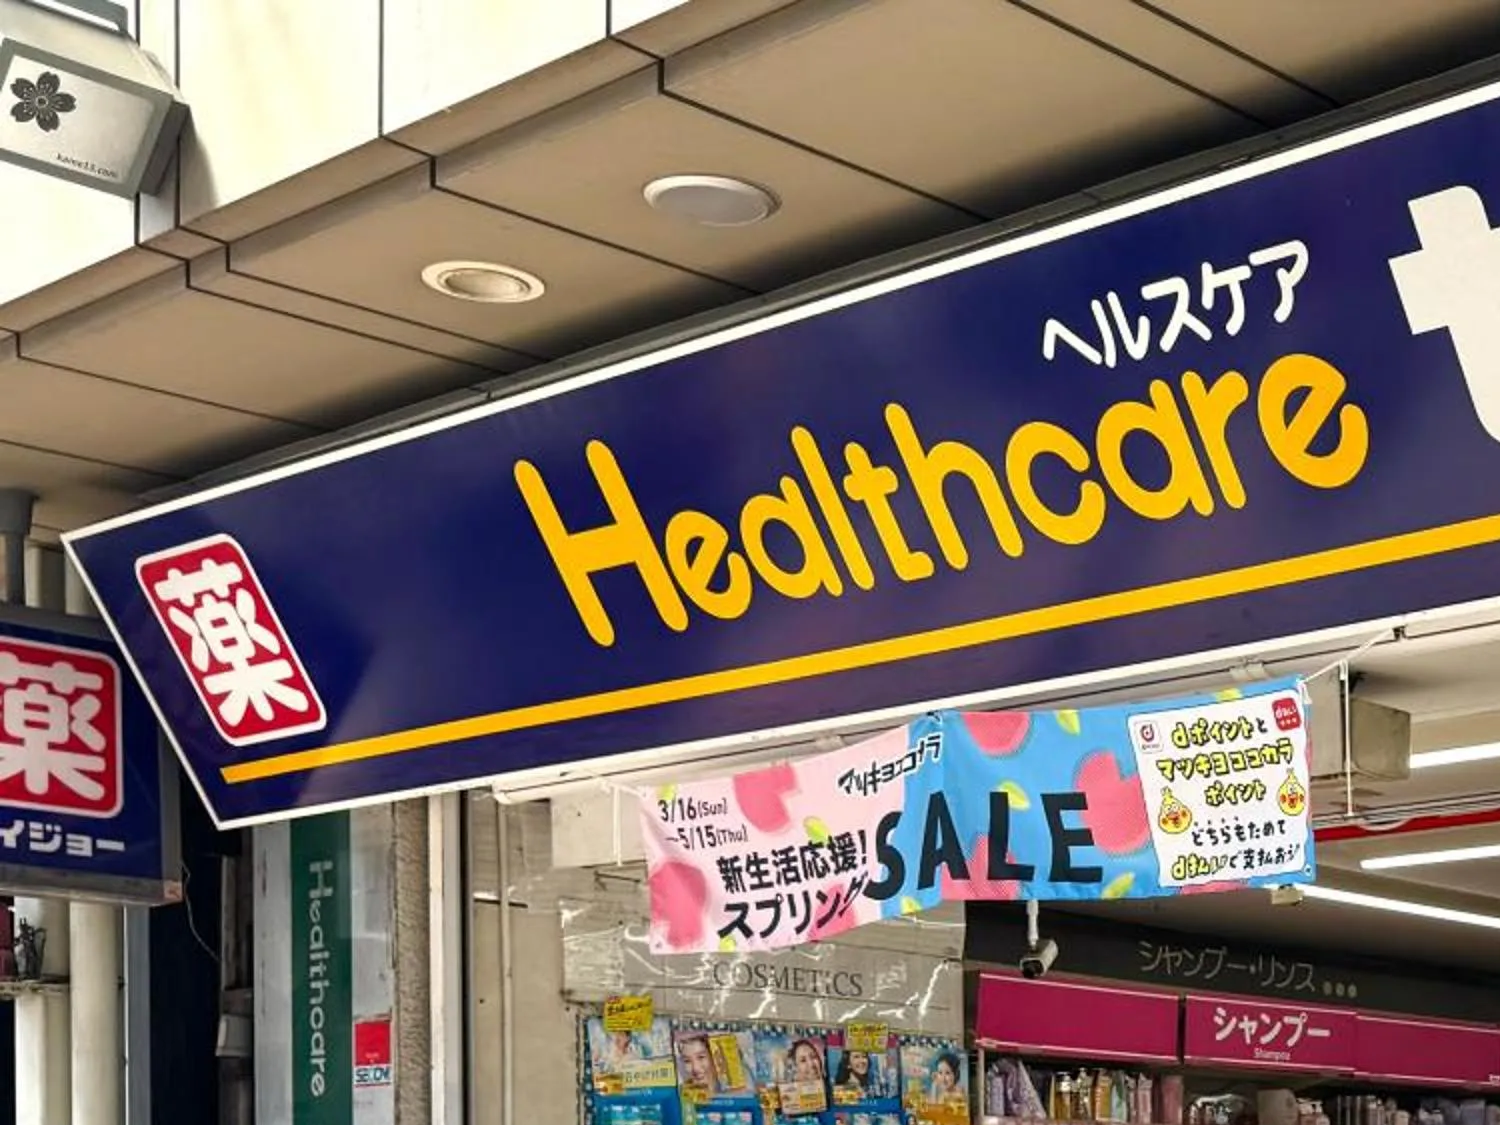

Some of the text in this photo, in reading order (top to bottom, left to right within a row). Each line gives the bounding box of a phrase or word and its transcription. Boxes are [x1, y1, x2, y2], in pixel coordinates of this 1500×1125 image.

[1042, 238, 1310, 368] ヘルスケア
[514, 353, 1368, 647] Healthcare
[155, 558, 308, 726] 薬
[0, 653, 105, 800] 薬
[1156, 737, 1294, 782] マツキヨココカラ
[862, 791, 1103, 900] SALE
[1204, 778, 1267, 808] ポイント
[309, 861, 333, 1097] Healthcare
[711, 958, 864, 998] COSMETICS
[1213, 1007, 1331, 1047] シャンプー
[355, 1066, 390, 1083] SECOM
